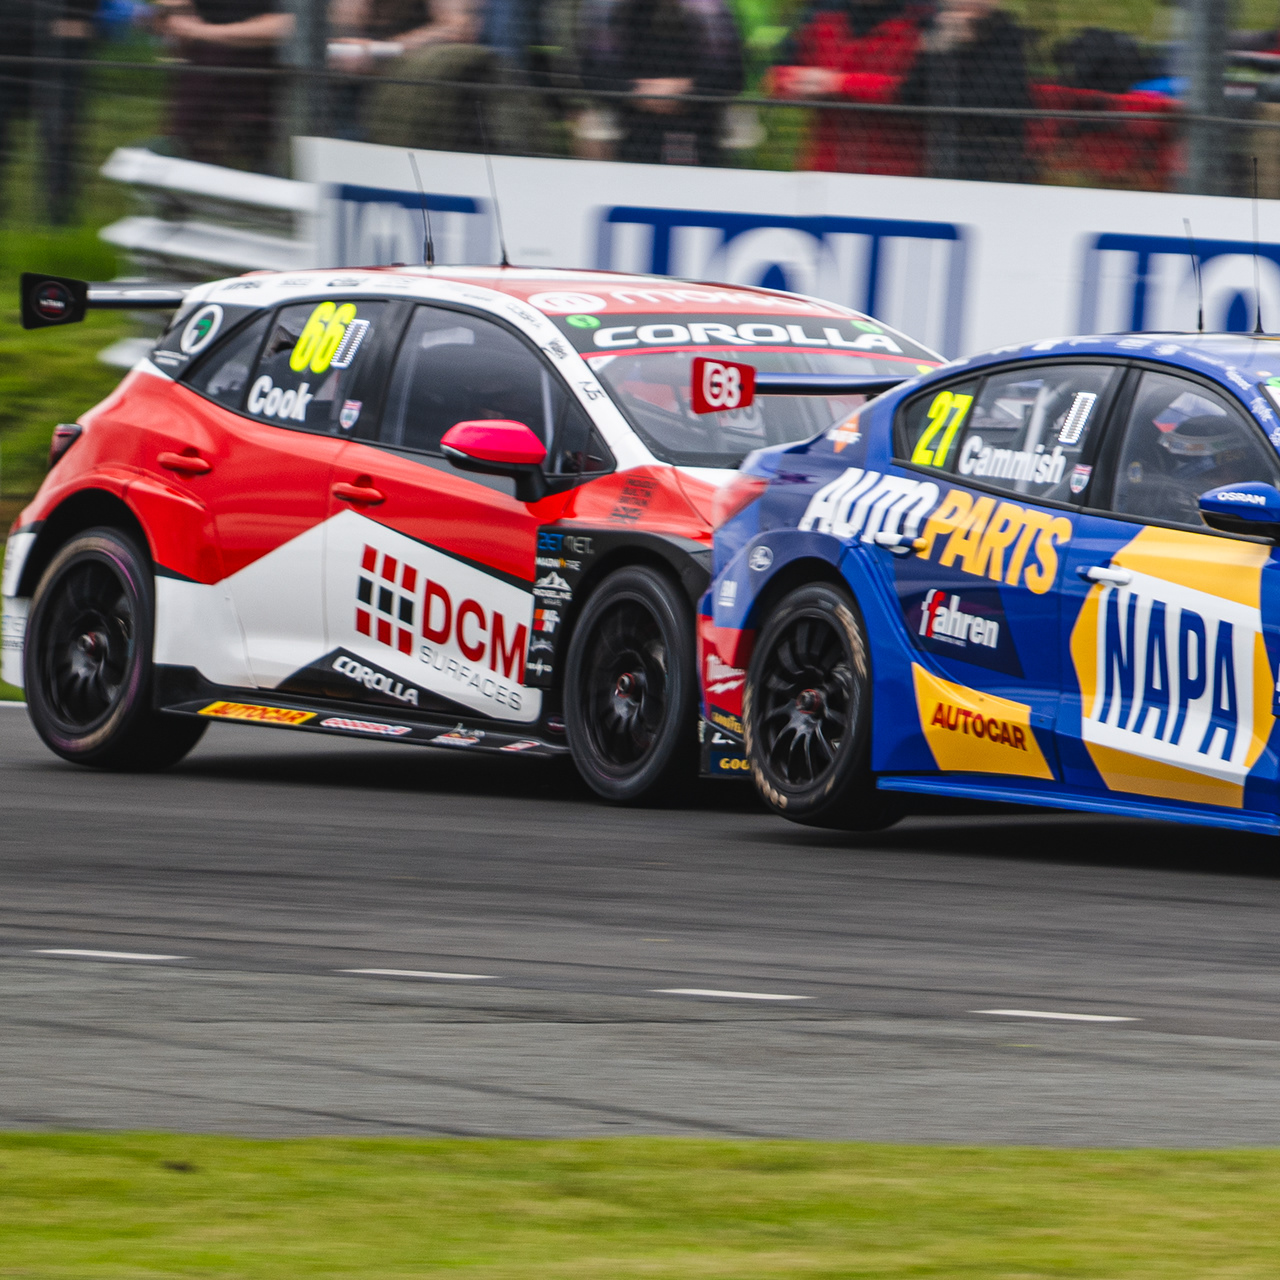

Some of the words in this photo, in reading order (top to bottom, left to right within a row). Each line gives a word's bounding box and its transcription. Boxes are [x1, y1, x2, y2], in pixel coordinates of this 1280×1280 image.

[290, 301, 358, 374] 66
[593, 323, 903, 354] COROLLA
[248, 375, 314, 422] Cook
[911, 391, 974, 467] 27
[959, 435, 1067, 485] Cammish
[1217, 492, 1266, 506] OSRAM
[798, 467, 940, 554] AUTO
[916, 489, 1073, 595] PARTS
[422, 578, 528, 686] DCM
[332, 656, 419, 705] COROLLA
[419, 645, 523, 711] SURFACES
[1101, 588, 1239, 762] NAPA
[206, 703, 310, 724] AUTOCAR
[931, 702, 1028, 752] AUTOCAR
